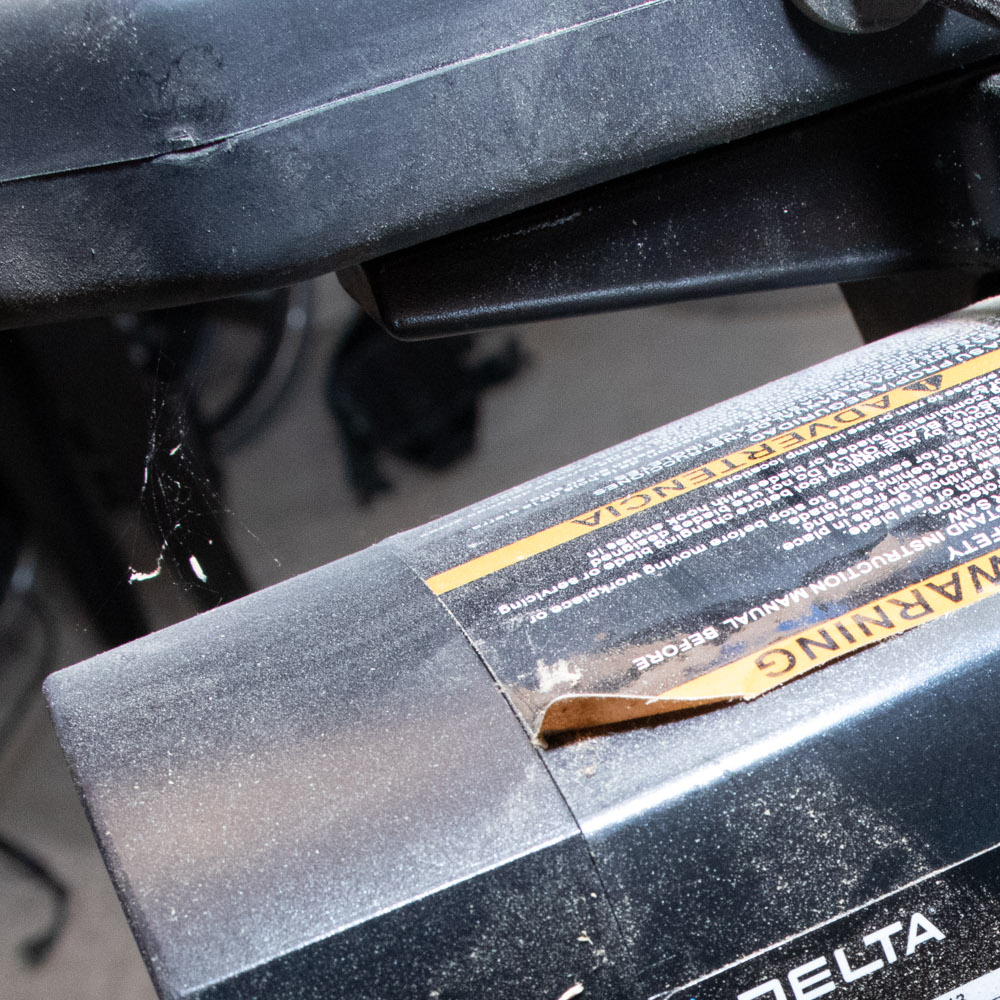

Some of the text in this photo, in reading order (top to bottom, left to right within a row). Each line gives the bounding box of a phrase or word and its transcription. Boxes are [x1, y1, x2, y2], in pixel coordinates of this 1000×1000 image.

[953, 346, 984, 362] SU
[871, 358, 953, 394] PROPIA
[747, 389, 874, 443] SEGURIDAD
[942, 406, 997, 432] power
[878, 420, 941, 449] BLADE
[920, 427, 945, 441] by
[938, 434, 976, 454] wait
[570, 394, 896, 532] ADVERTENCIA
[827, 436, 922, 479] unplugging
[877, 459, 913, 478] saw
[912, 449, 941, 465] for
[933, 453, 954, 465] or
[763, 478, 795, 495] not
[793, 474, 828, 493] tool
[794, 467, 822, 482] Do
[826, 473, 878, 499] blade
[874, 461, 935, 490] behind
[885, 457, 970, 497] operation
[911, 466, 978, 498] without
[953, 470, 995, 493] path
[729, 490, 763, 507] use
[733, 488, 793, 517] before
[806, 494, 826, 507] to
[836, 485, 874, 505] saw
[848, 490, 913, 523] guards
[897, 495, 936, 515] saw
[933, 487, 957, 501] of
[669, 503, 731, 533] blades
[765, 500, 807, 523] stop
[781, 500, 837, 528] blade.
[795, 492, 887, 534] free-hand.
[831, 518, 851, 531] in
[842, 510, 899, 539] blade.
[941, 498, 993, 524] SAW.
[652, 511, 735, 550] changing
[708, 518, 768, 548] before
[774, 524, 832, 554] place.
[588, 528, 671, 567] designed
[602, 546, 653, 572] blade
[640, 541, 708, 575] moving
[580, 567, 600, 579] or
[808, 531, 946, 593] INSTRUCTION
[547, 569, 643, 615] workpiece
[527, 610, 548, 623] or
[721, 586, 810, 630] MANUAL
[631, 626, 719, 670] BEFORE
